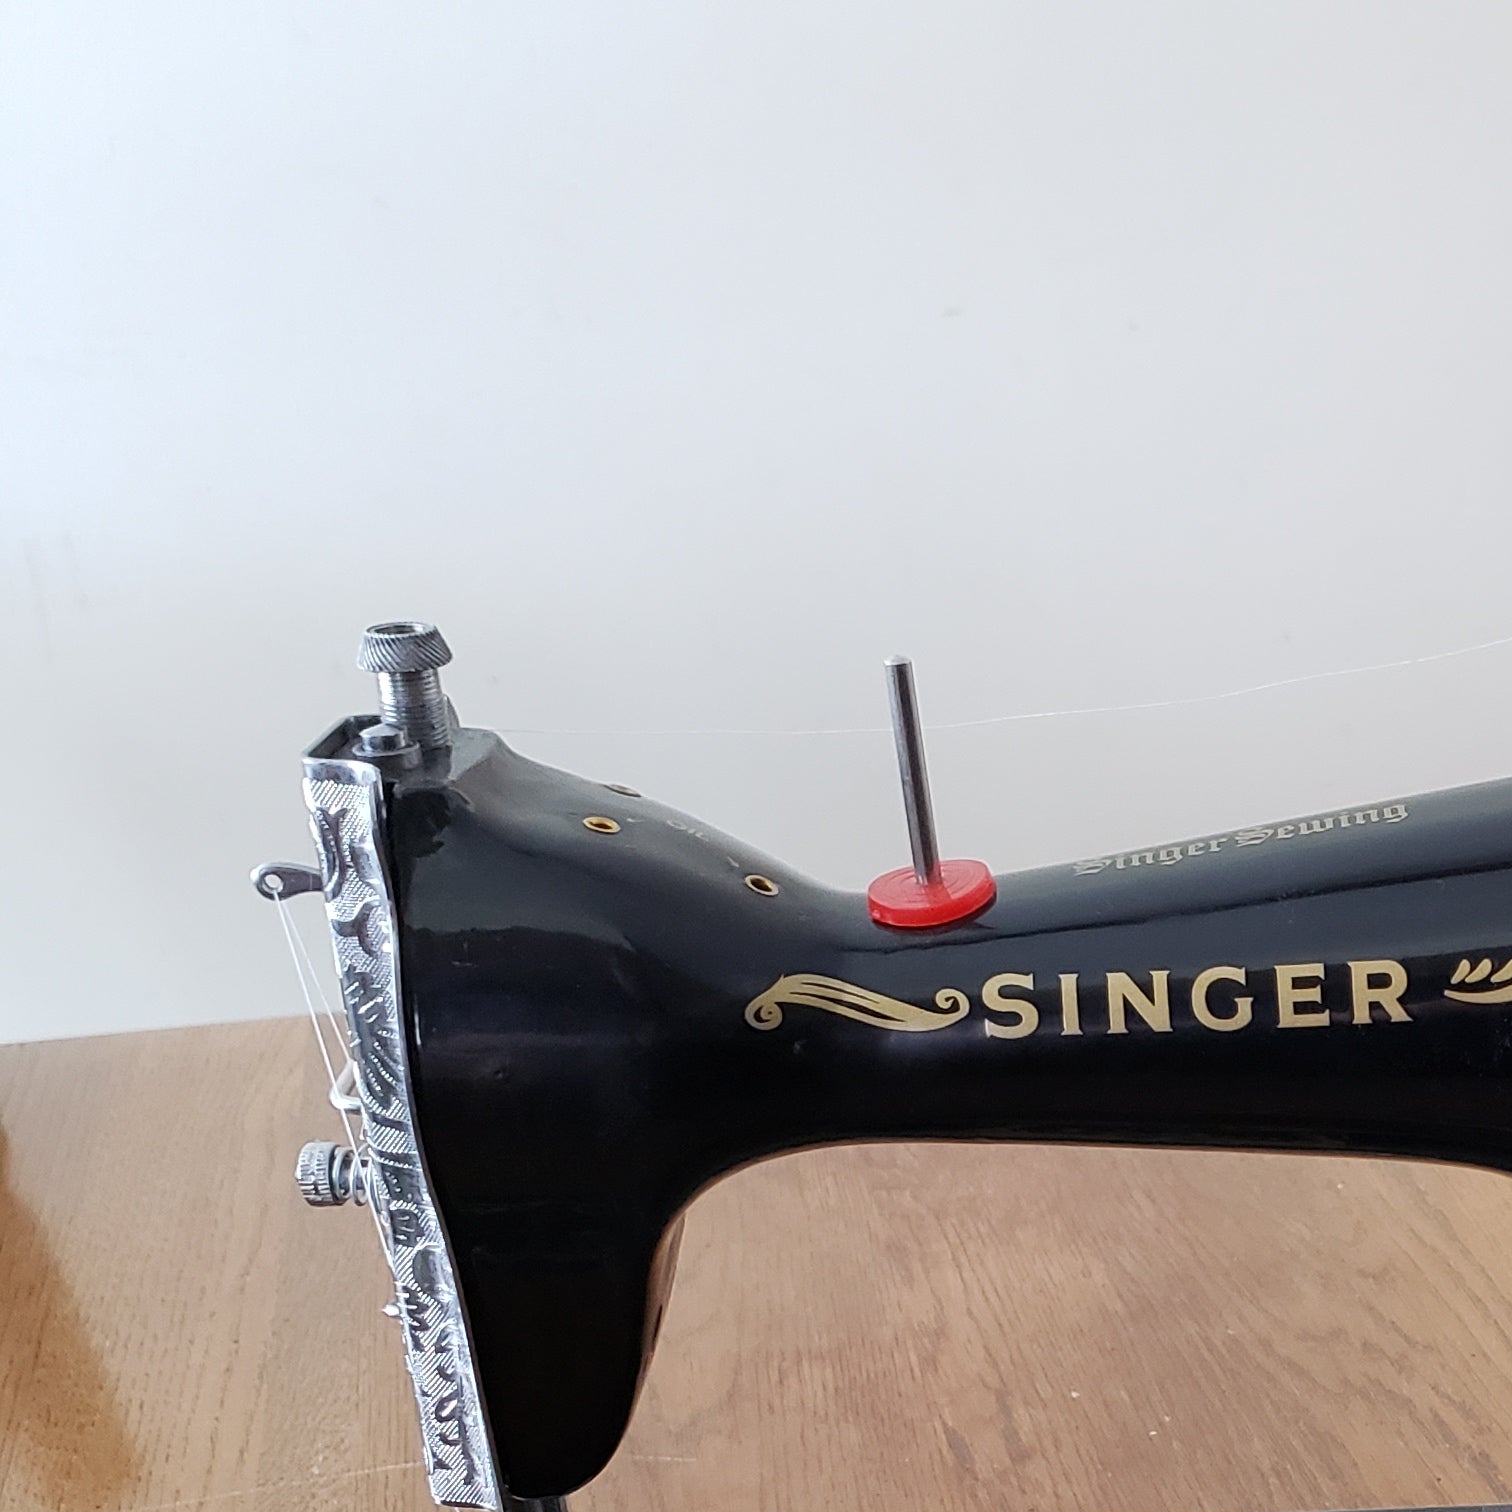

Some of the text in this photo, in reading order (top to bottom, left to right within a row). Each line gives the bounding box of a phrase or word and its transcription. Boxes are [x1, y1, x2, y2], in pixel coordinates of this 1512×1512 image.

[1073, 803, 1410, 876] Singer Sewing
[981, 958, 1414, 1040] SINGER
